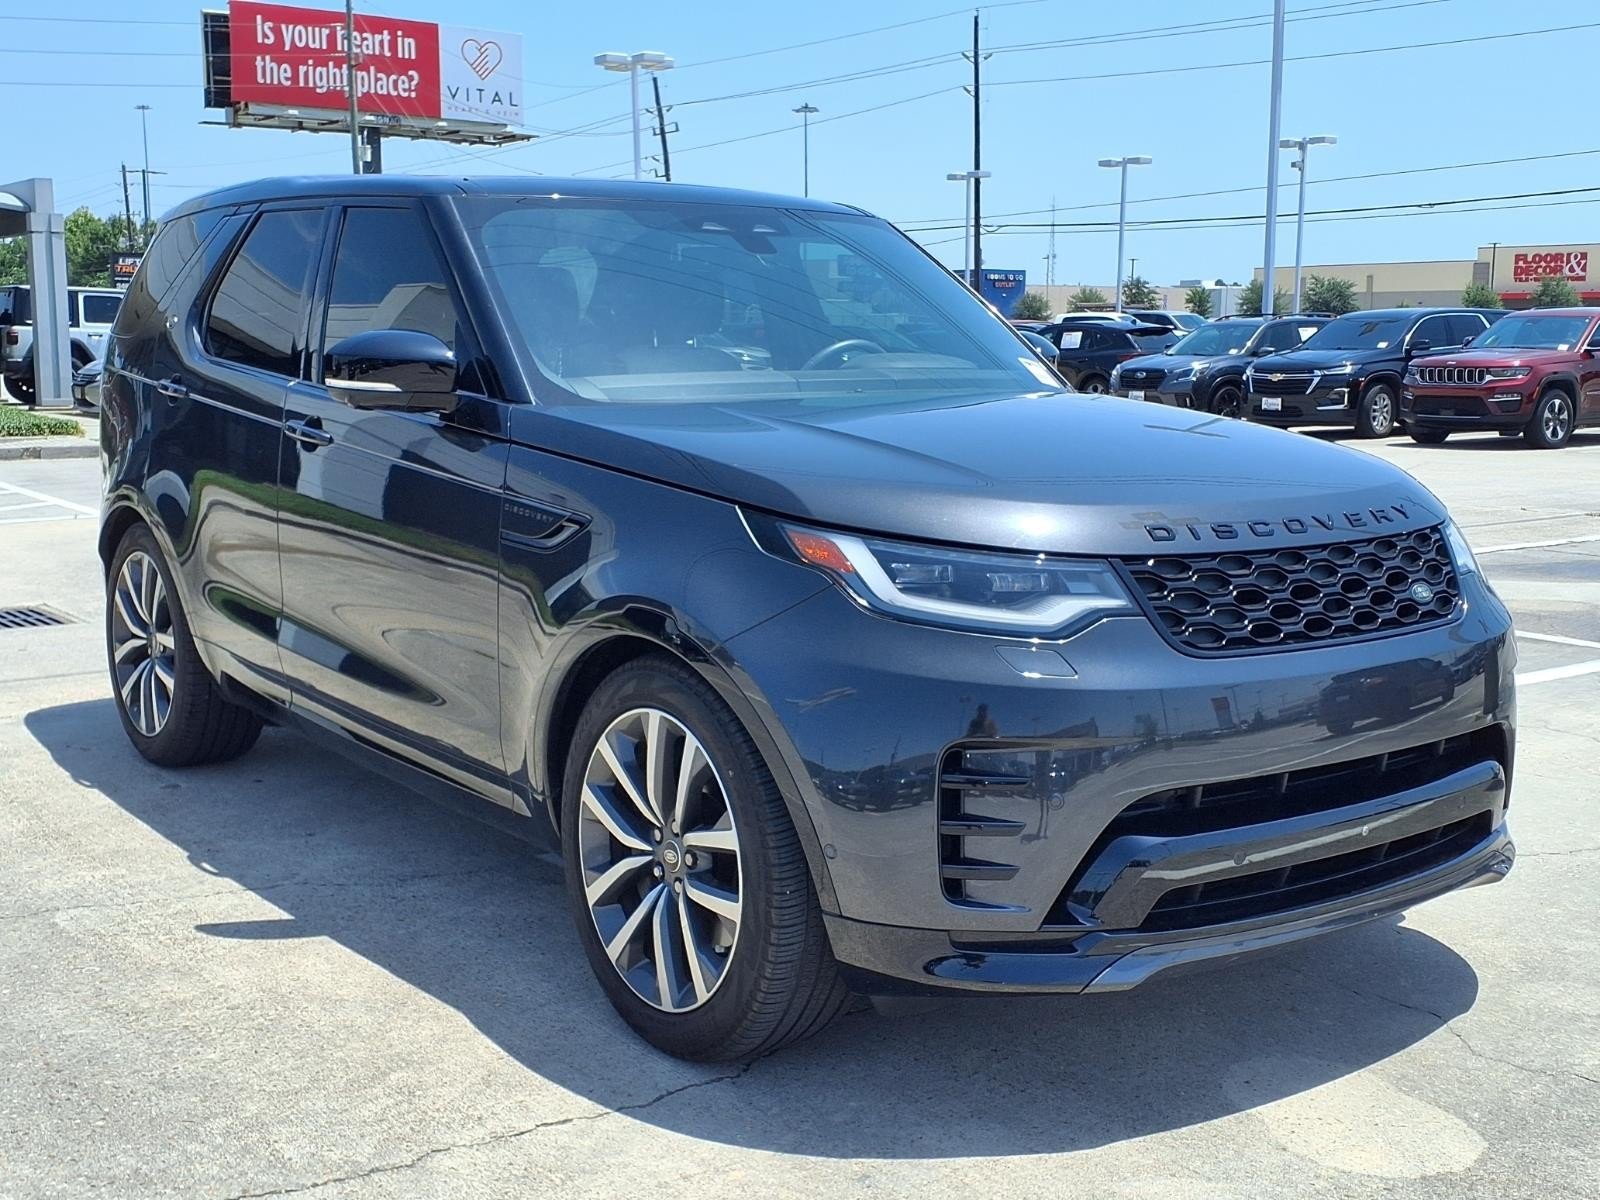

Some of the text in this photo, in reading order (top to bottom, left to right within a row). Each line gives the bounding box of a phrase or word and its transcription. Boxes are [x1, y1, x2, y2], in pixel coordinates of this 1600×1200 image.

[256, 14, 416, 60] Is your heart in
[255, 55, 420, 98] the right place?
[447, 85, 519, 107] VITAL
[1514, 252, 1588, 276] FLOOR &
[1514, 264, 1565, 277] DECOR
[503, 503, 555, 523] DISCOVERY
[1144, 503, 1411, 542] DISCOVERY
